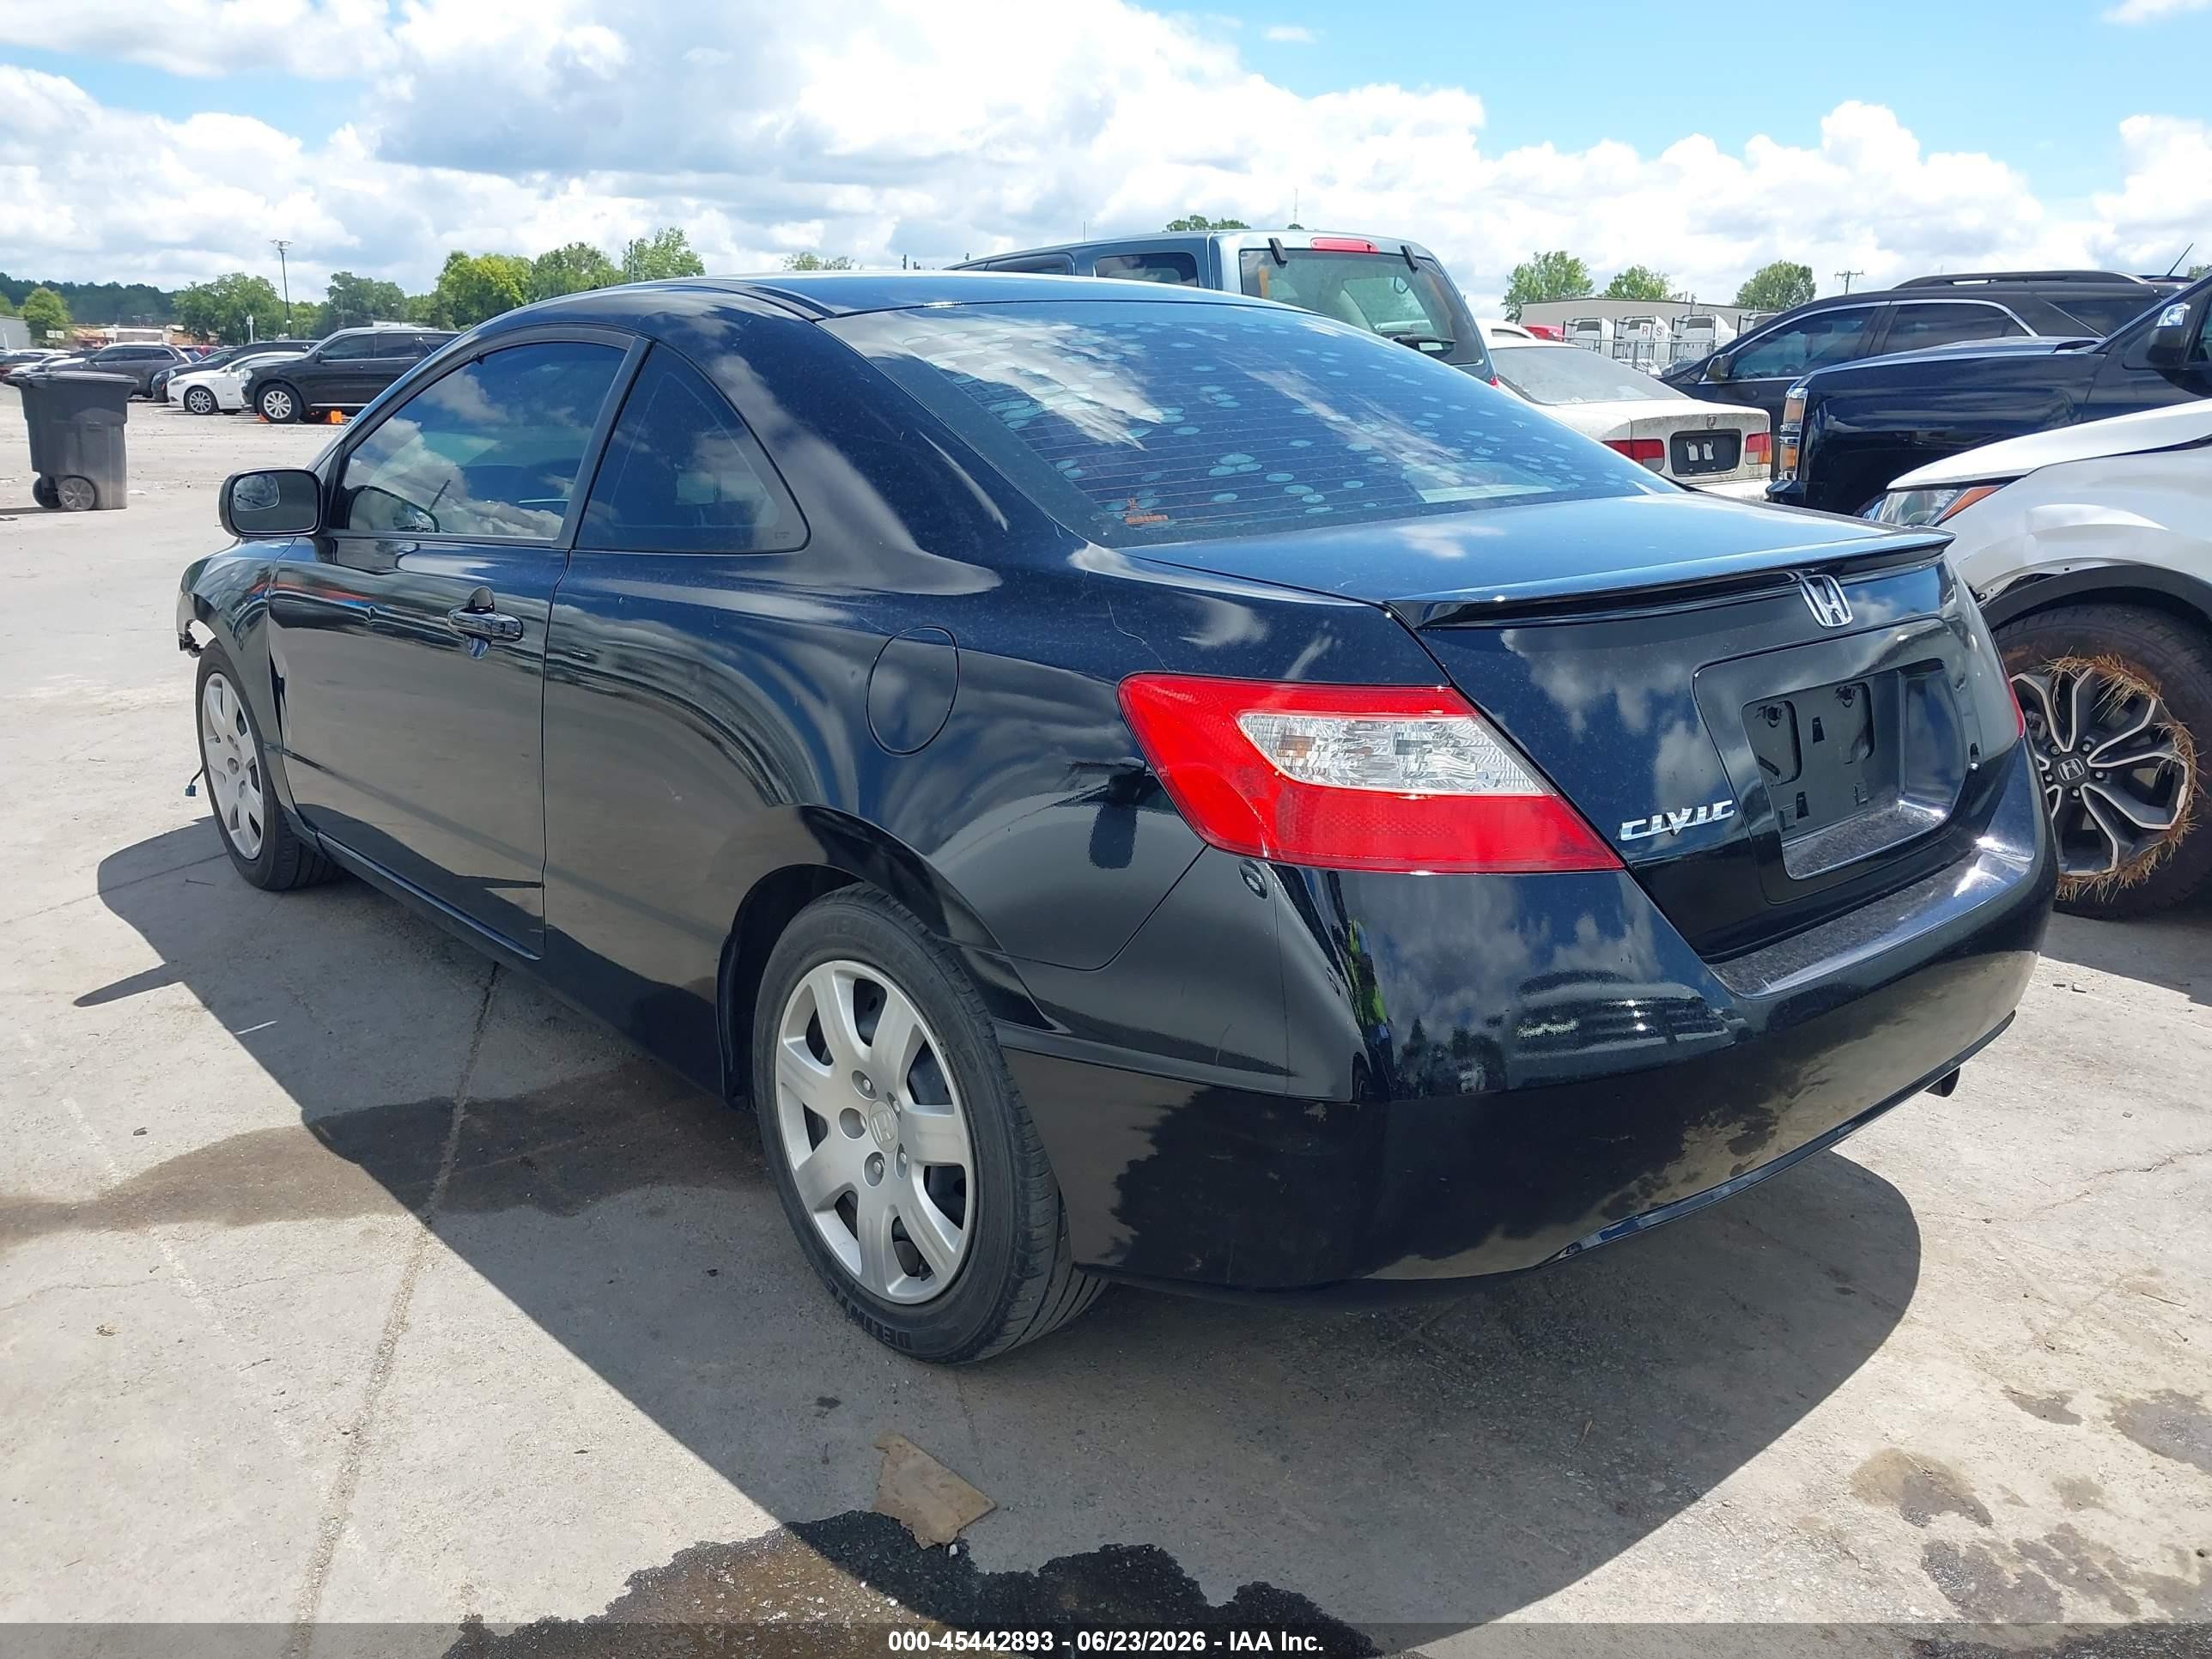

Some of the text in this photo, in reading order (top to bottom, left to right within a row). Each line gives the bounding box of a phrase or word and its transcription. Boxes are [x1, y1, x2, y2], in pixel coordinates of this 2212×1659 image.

[1641, 326, 1649, 336] R
[1656, 326, 1663, 337] S
[1620, 799, 1735, 842] CIVIC
